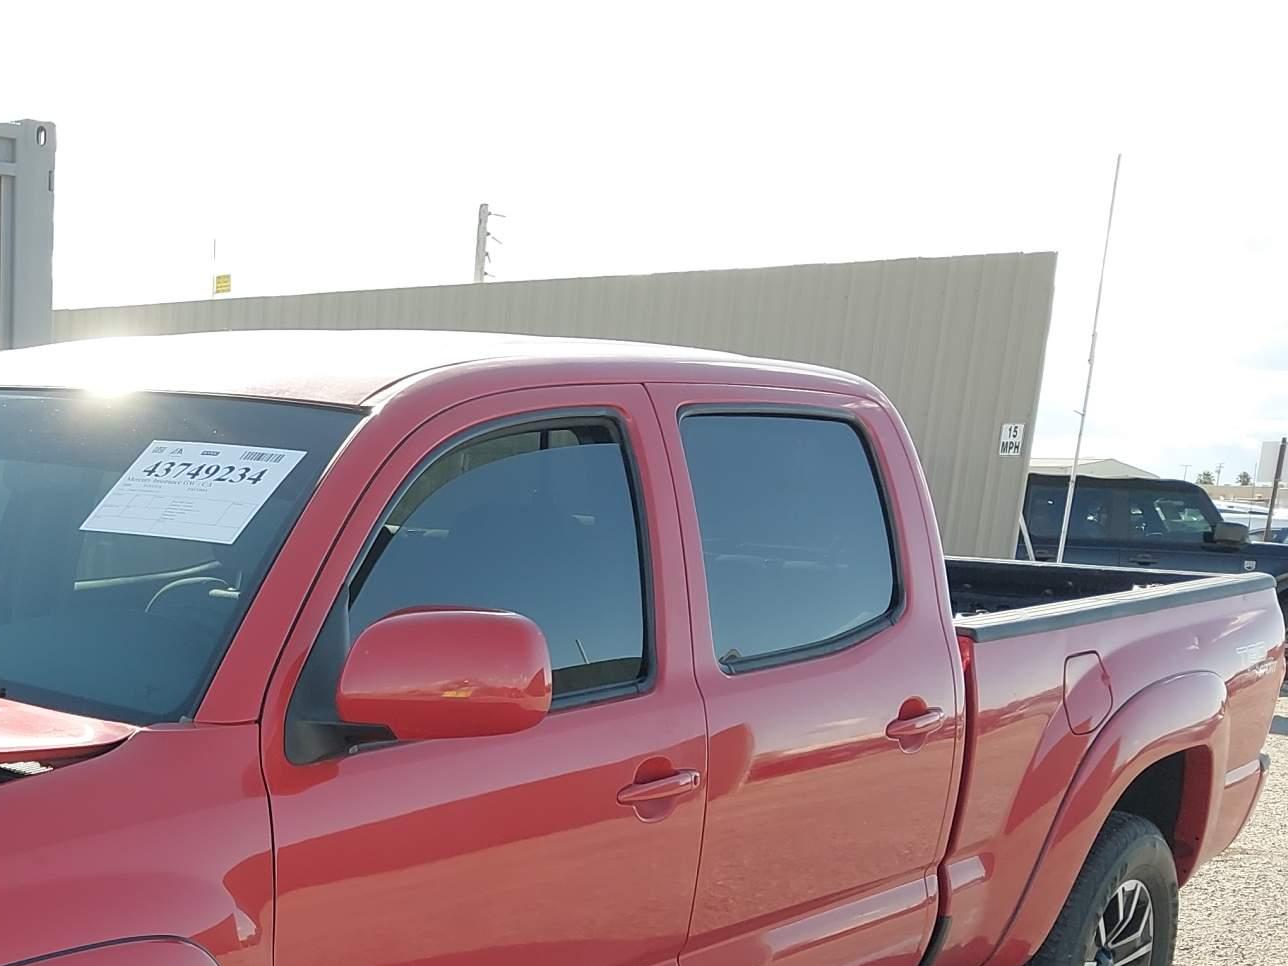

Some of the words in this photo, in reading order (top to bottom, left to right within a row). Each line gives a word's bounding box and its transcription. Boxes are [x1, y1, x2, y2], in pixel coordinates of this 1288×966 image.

[1009, 426, 1018, 438] 15
[1001, 441, 1020, 453] MPH
[142, 461, 268, 484] 43749234
